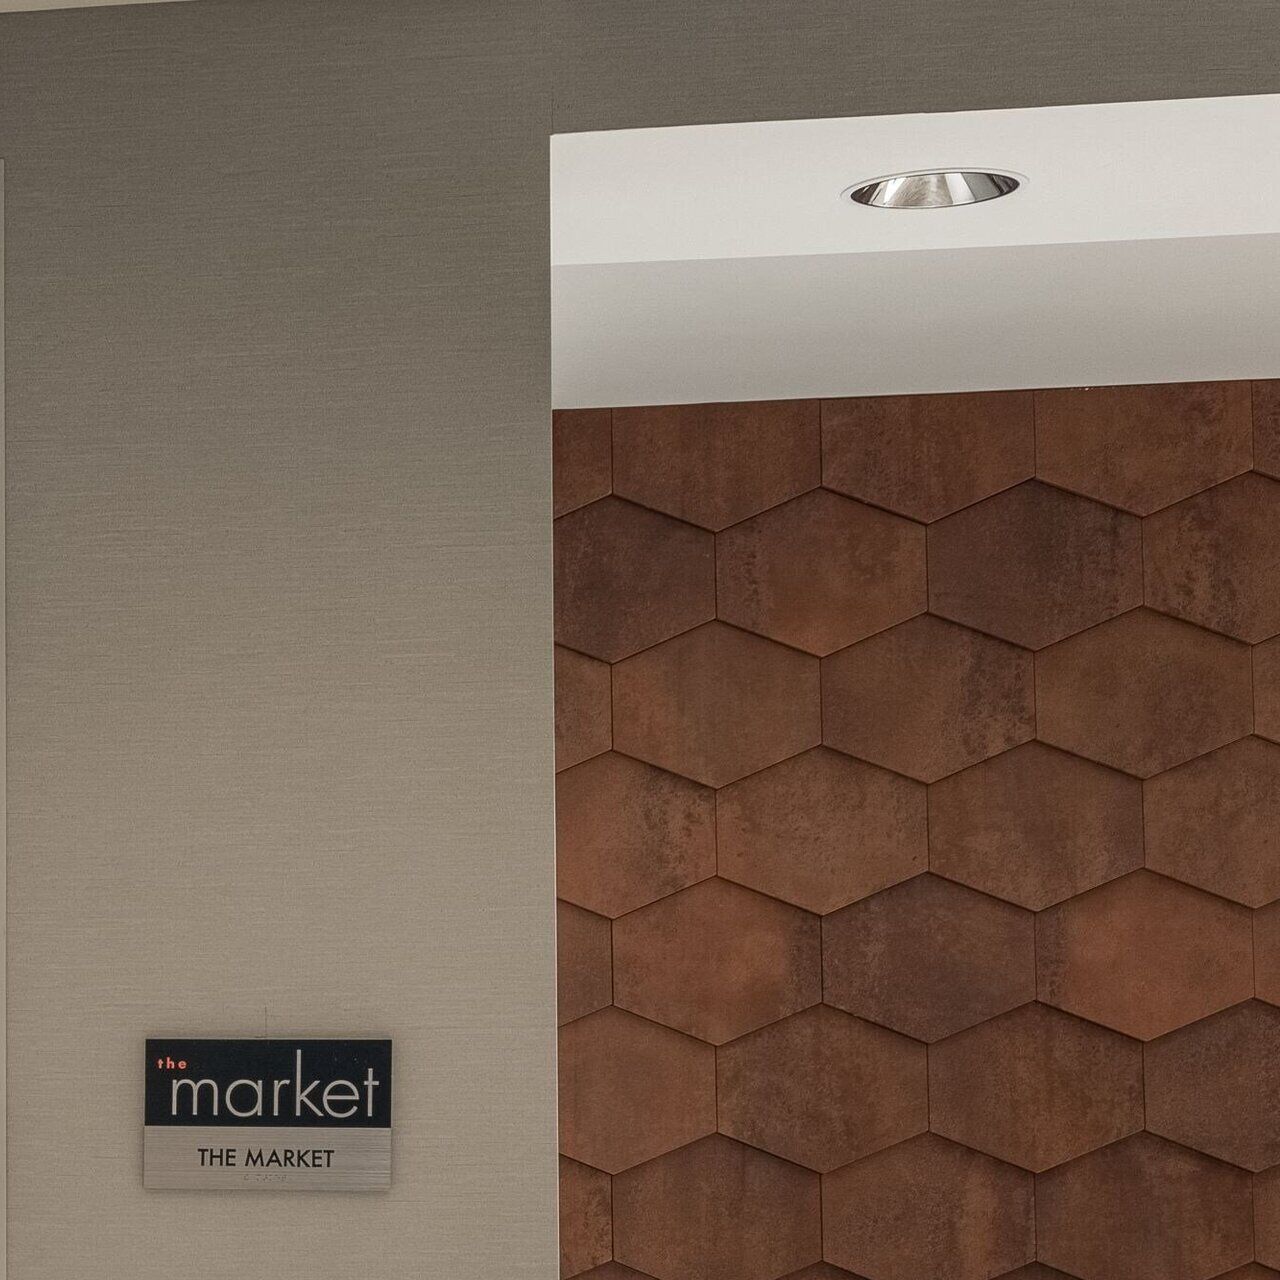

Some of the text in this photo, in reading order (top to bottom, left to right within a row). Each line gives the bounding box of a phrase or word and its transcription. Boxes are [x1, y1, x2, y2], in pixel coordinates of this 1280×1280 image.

[156, 1056, 188, 1070] the
[171, 1049, 380, 1118] market
[197, 1148, 335, 1168] THE MARKET
